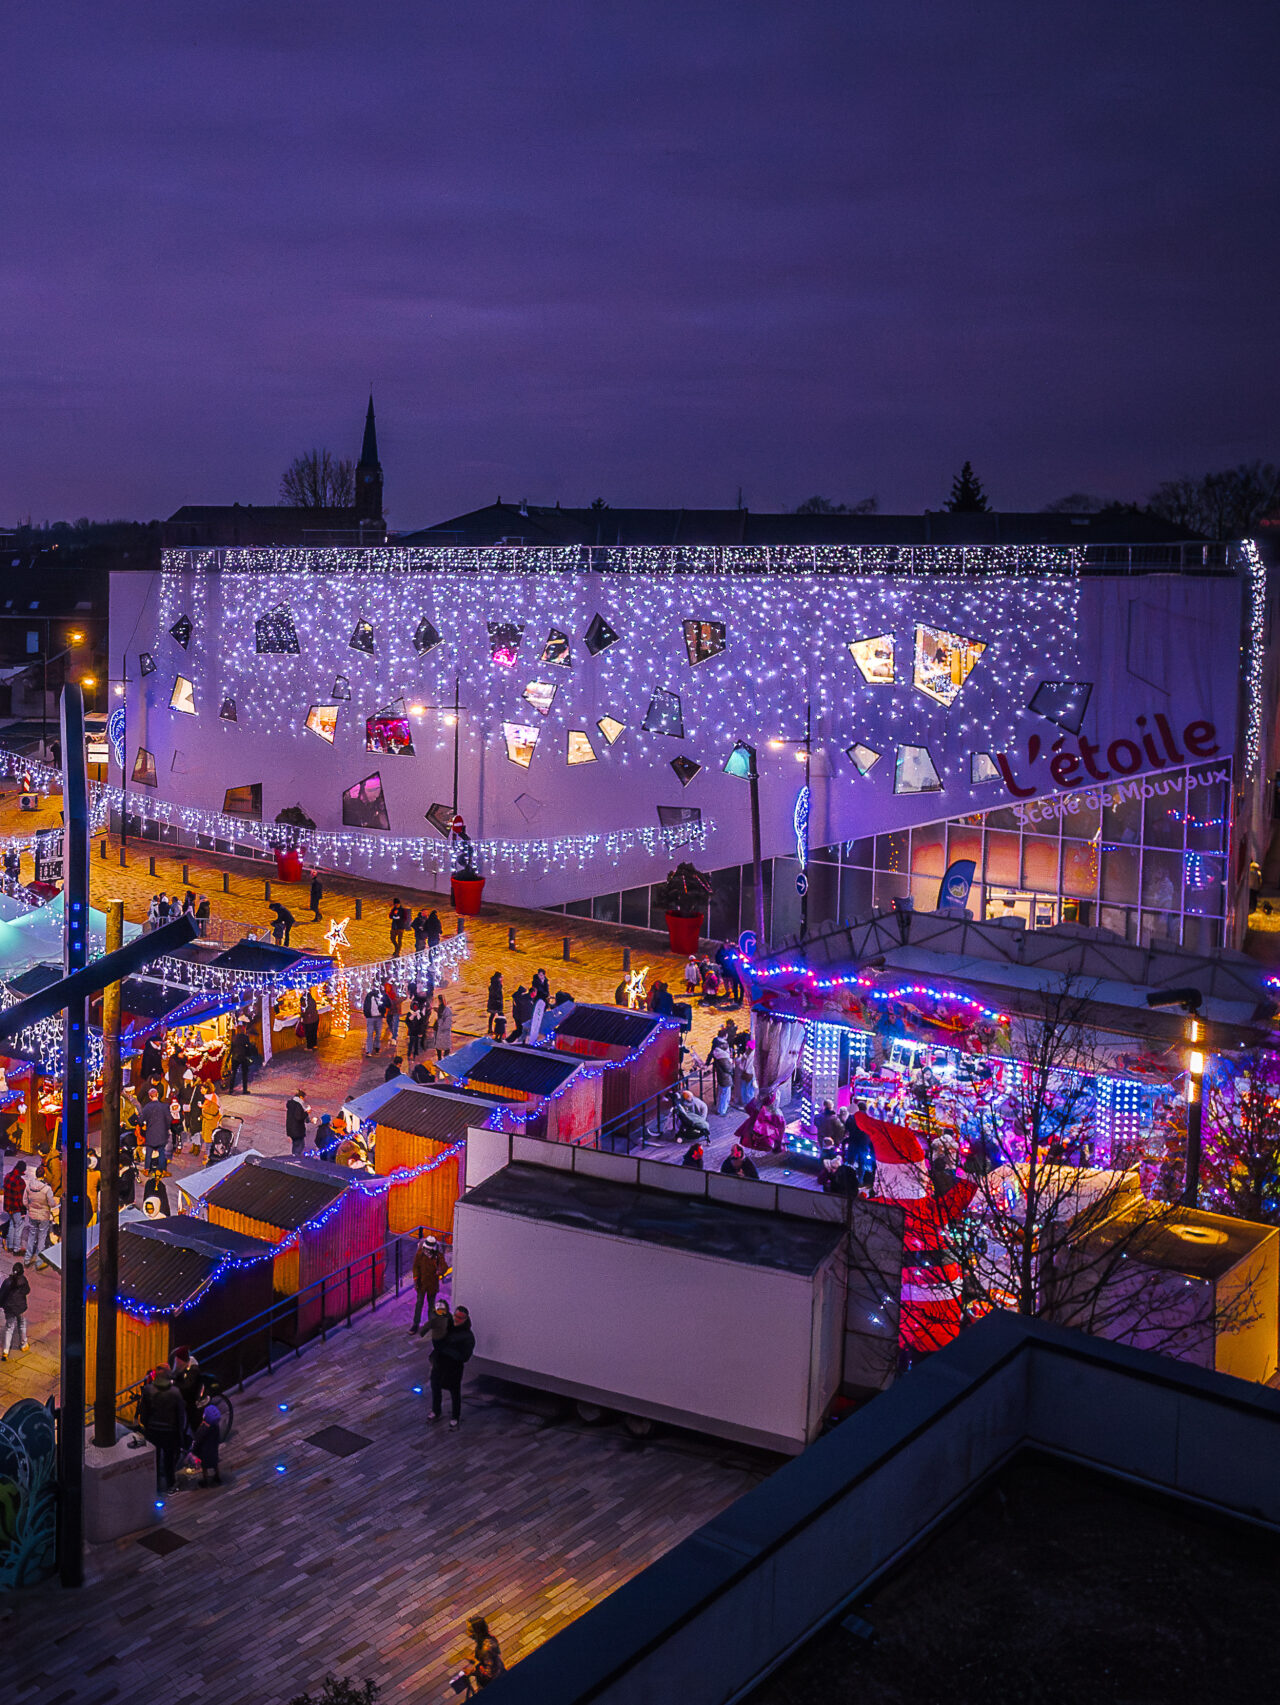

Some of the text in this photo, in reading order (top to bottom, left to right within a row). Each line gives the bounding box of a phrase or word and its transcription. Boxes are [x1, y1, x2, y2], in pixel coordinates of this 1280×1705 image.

[997, 713, 1221, 798] L'étoile
[1085, 788, 1114, 810] de
[1116, 768, 1230, 803] Mouvaux
